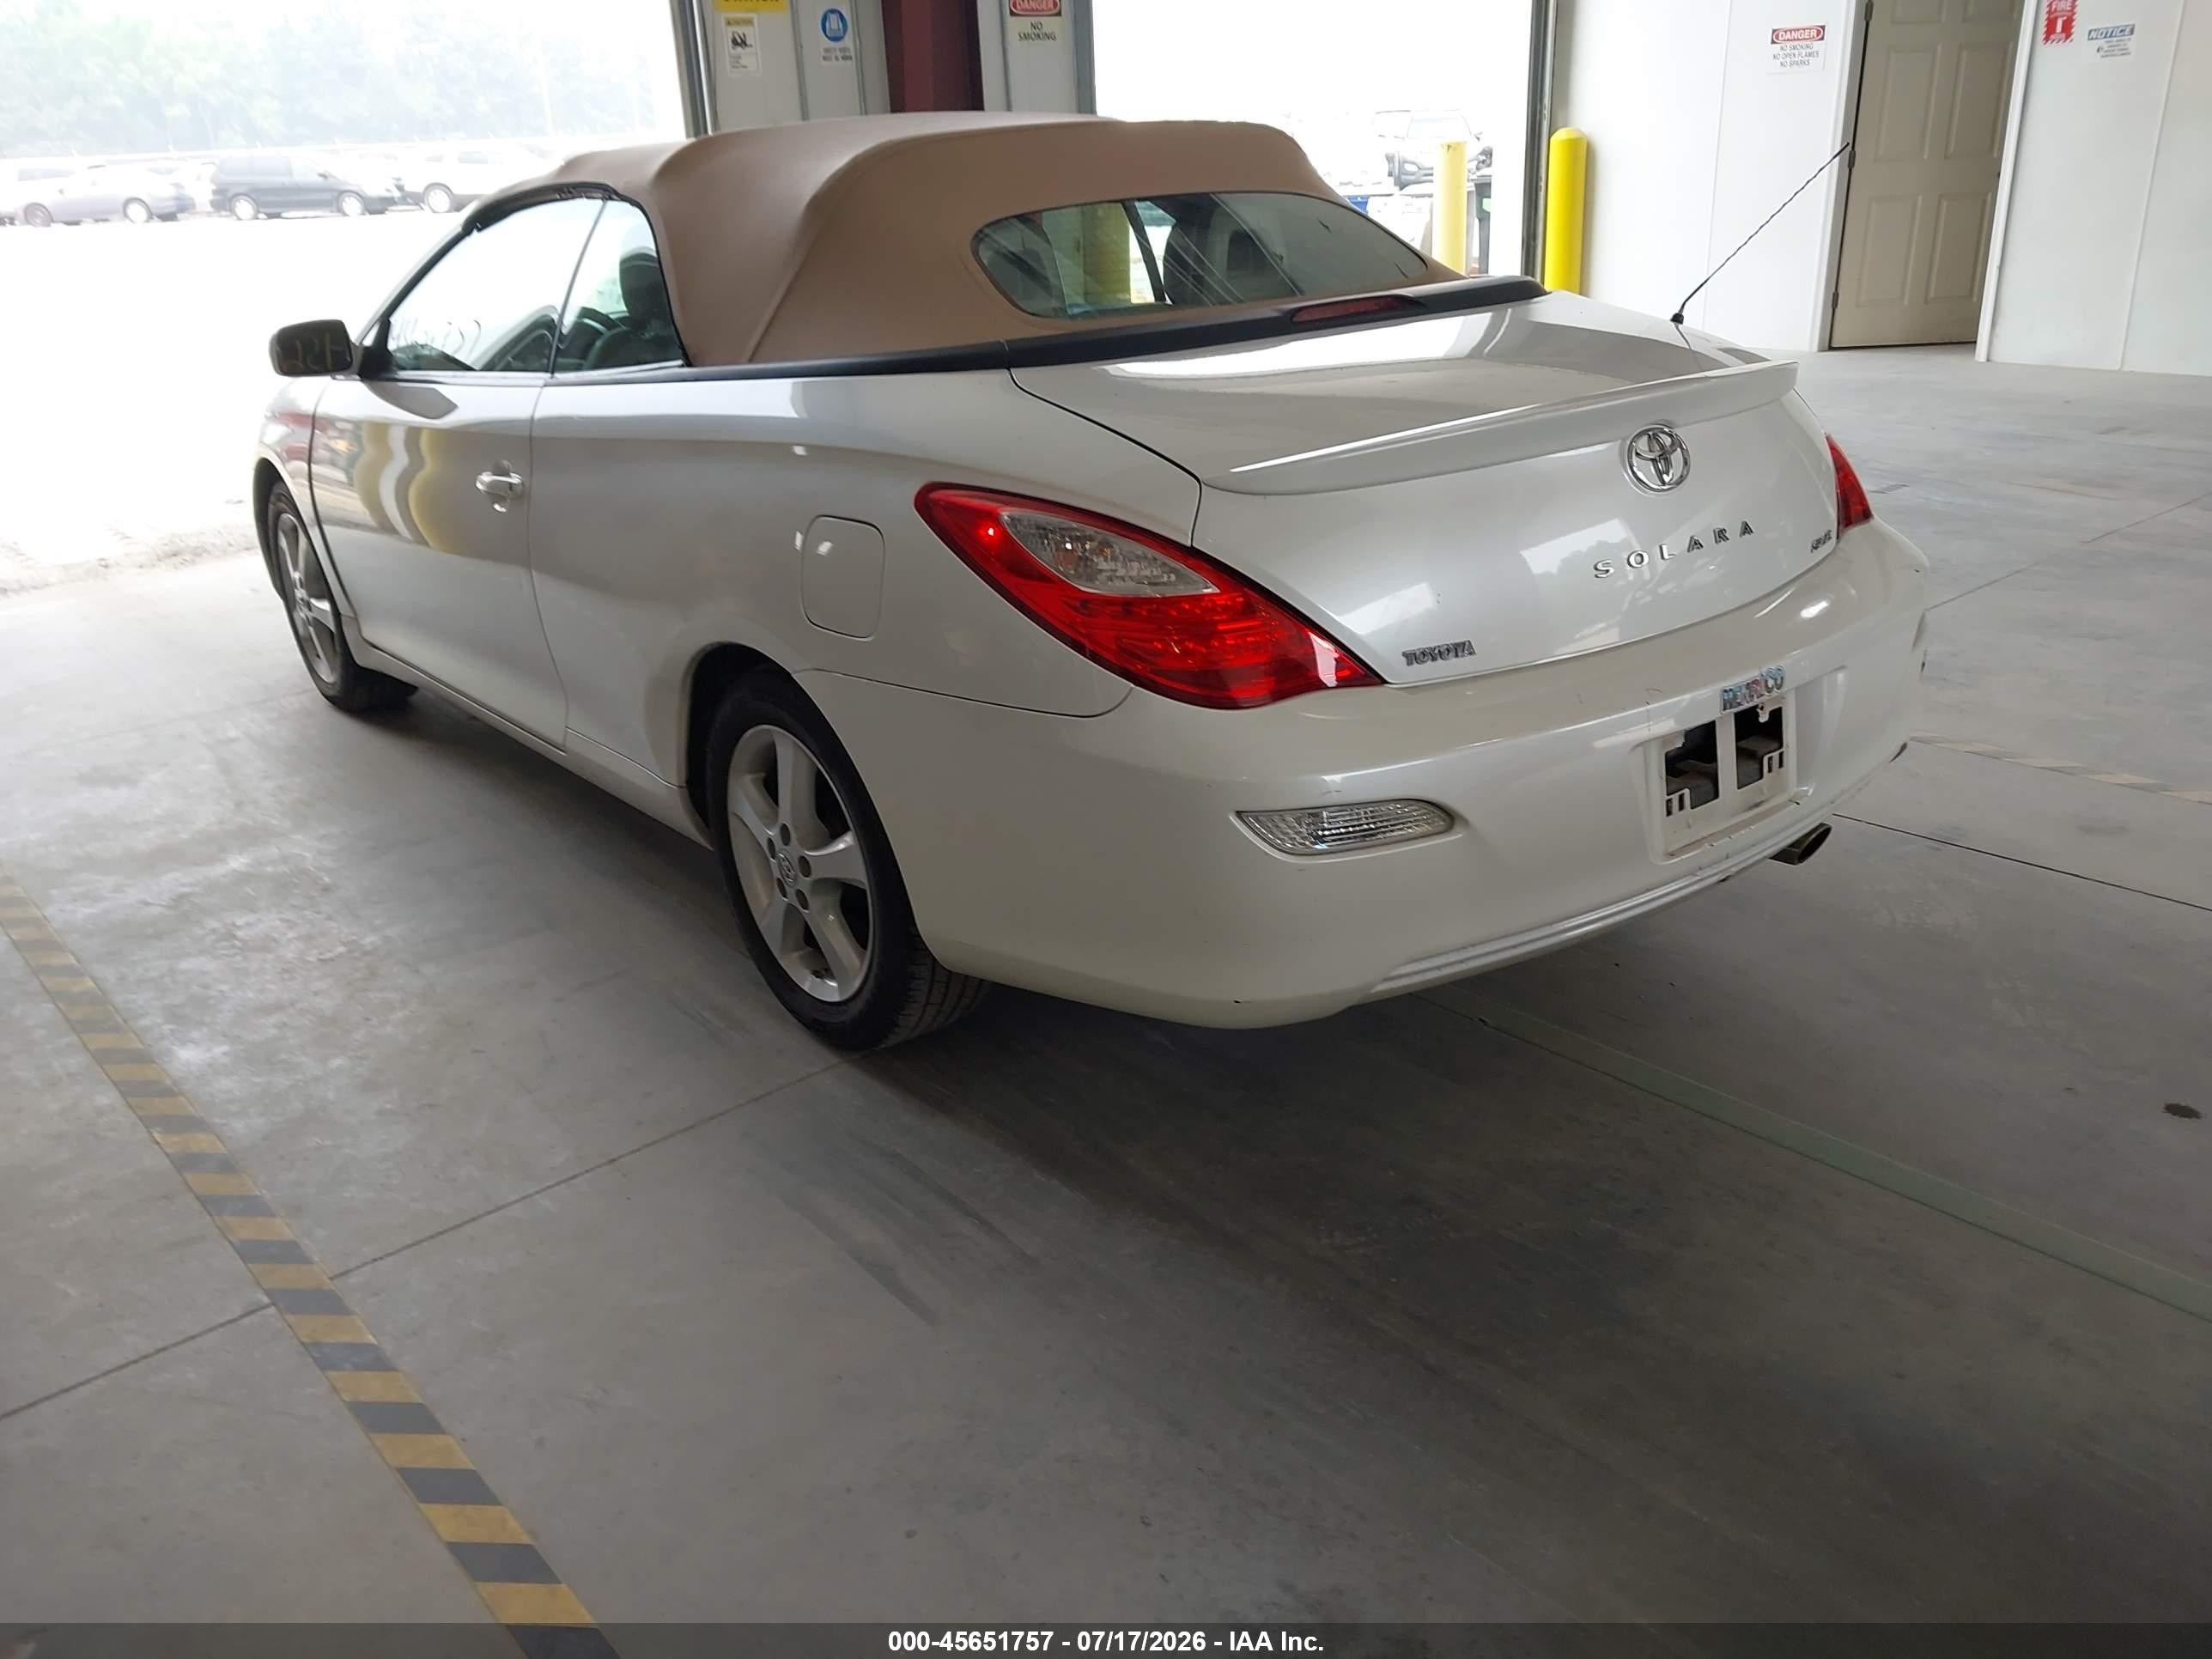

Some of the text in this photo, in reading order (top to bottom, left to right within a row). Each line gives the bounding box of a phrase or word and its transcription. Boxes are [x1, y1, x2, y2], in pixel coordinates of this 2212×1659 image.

[1030, 21, 1043, 31] NO
[1018, 32, 1057, 41] SMOKING
[1778, 28, 1818, 40] DANGER
[2088, 26, 2131, 40] NOTICE
[1789, 42, 1814, 51] SMOKING
[1593, 520, 1754, 580] SOLARA
[1401, 640, 1476, 667] TOYOTA
